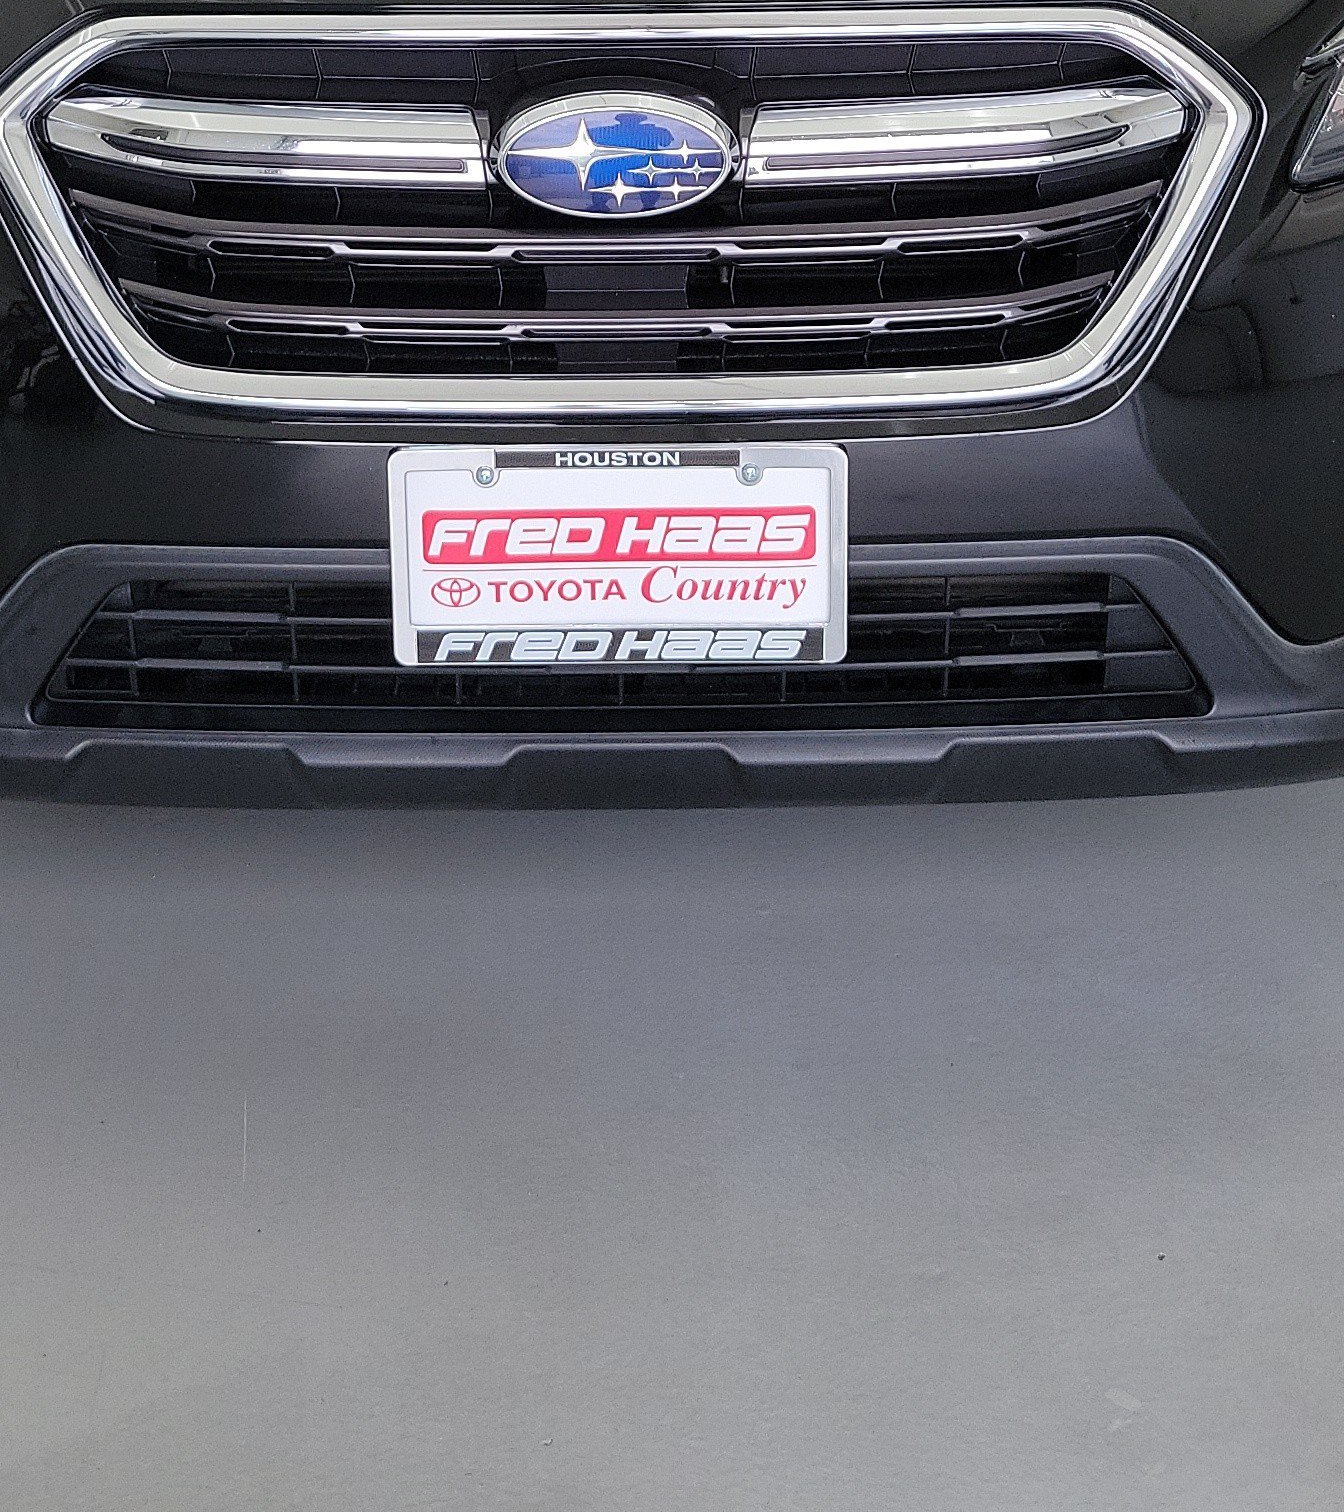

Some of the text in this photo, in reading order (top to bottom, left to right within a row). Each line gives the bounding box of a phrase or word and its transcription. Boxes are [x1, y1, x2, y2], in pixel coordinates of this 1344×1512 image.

[555, 451, 680, 467] HOUSTON
[488, 565, 807, 609] TOYOTA Country
